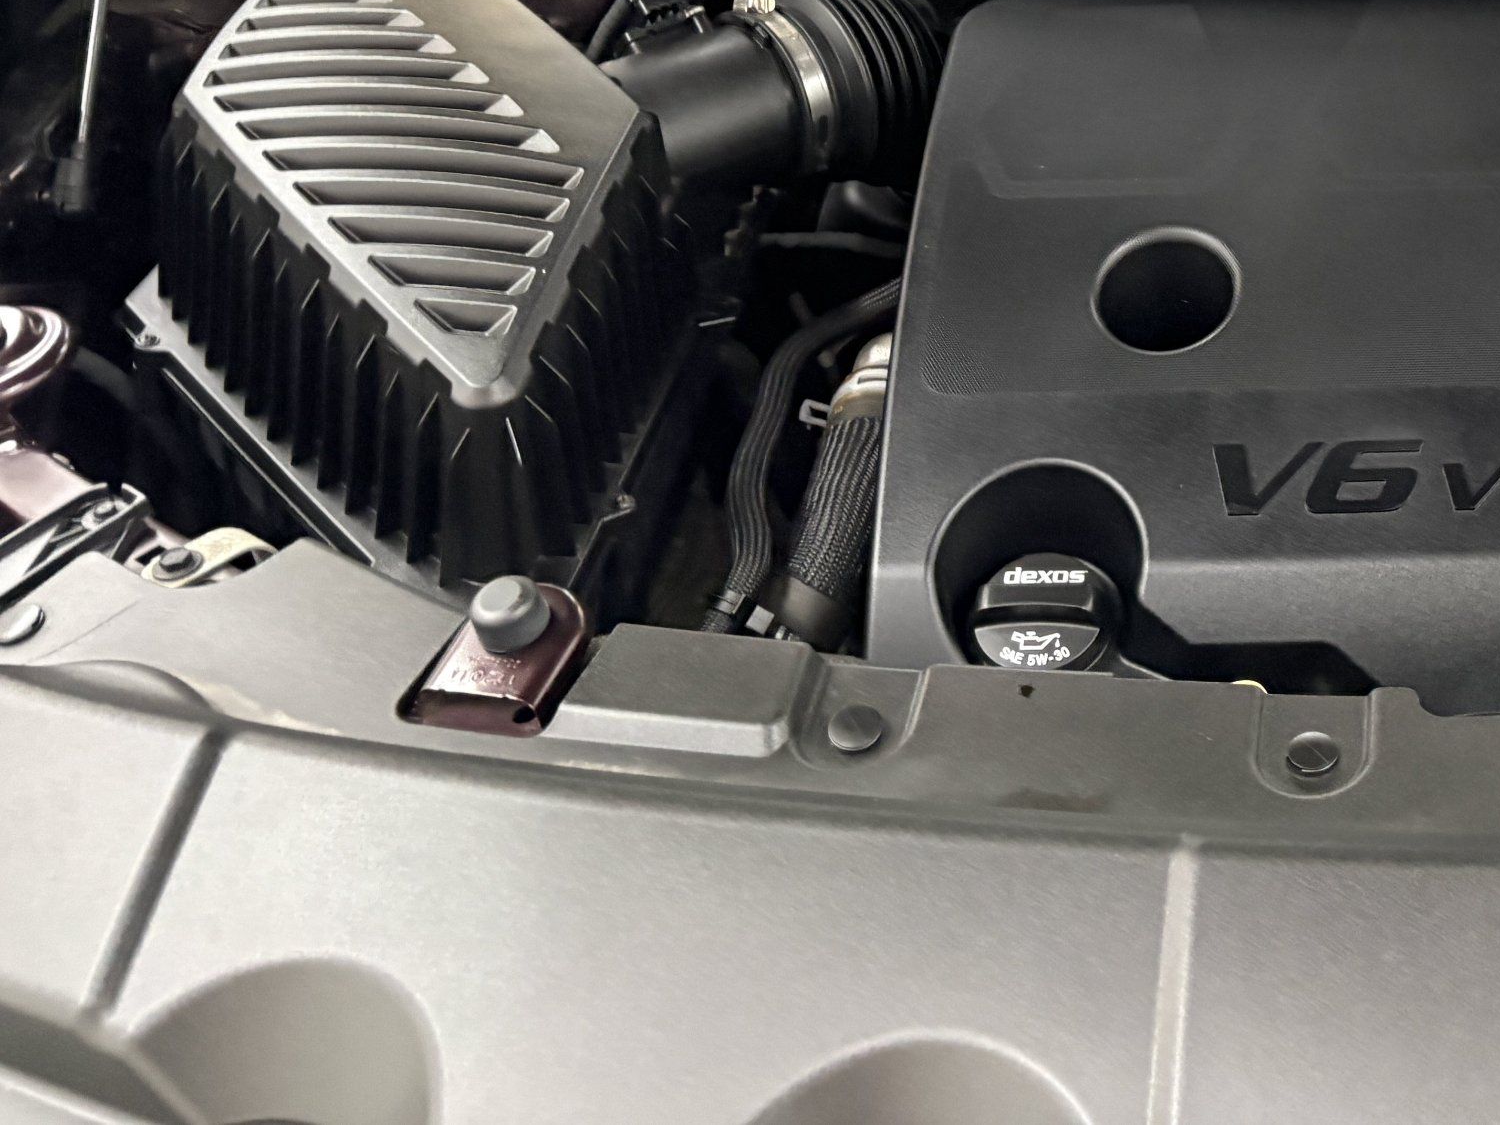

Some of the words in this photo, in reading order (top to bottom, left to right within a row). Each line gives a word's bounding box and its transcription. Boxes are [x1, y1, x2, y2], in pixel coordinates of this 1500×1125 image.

[1213, 439, 1425, 516] V6
[1003, 567, 1086, 584] dexos
[1000, 646, 1023, 664] SAE
[1027, 647, 1071, 666] 5W-30
